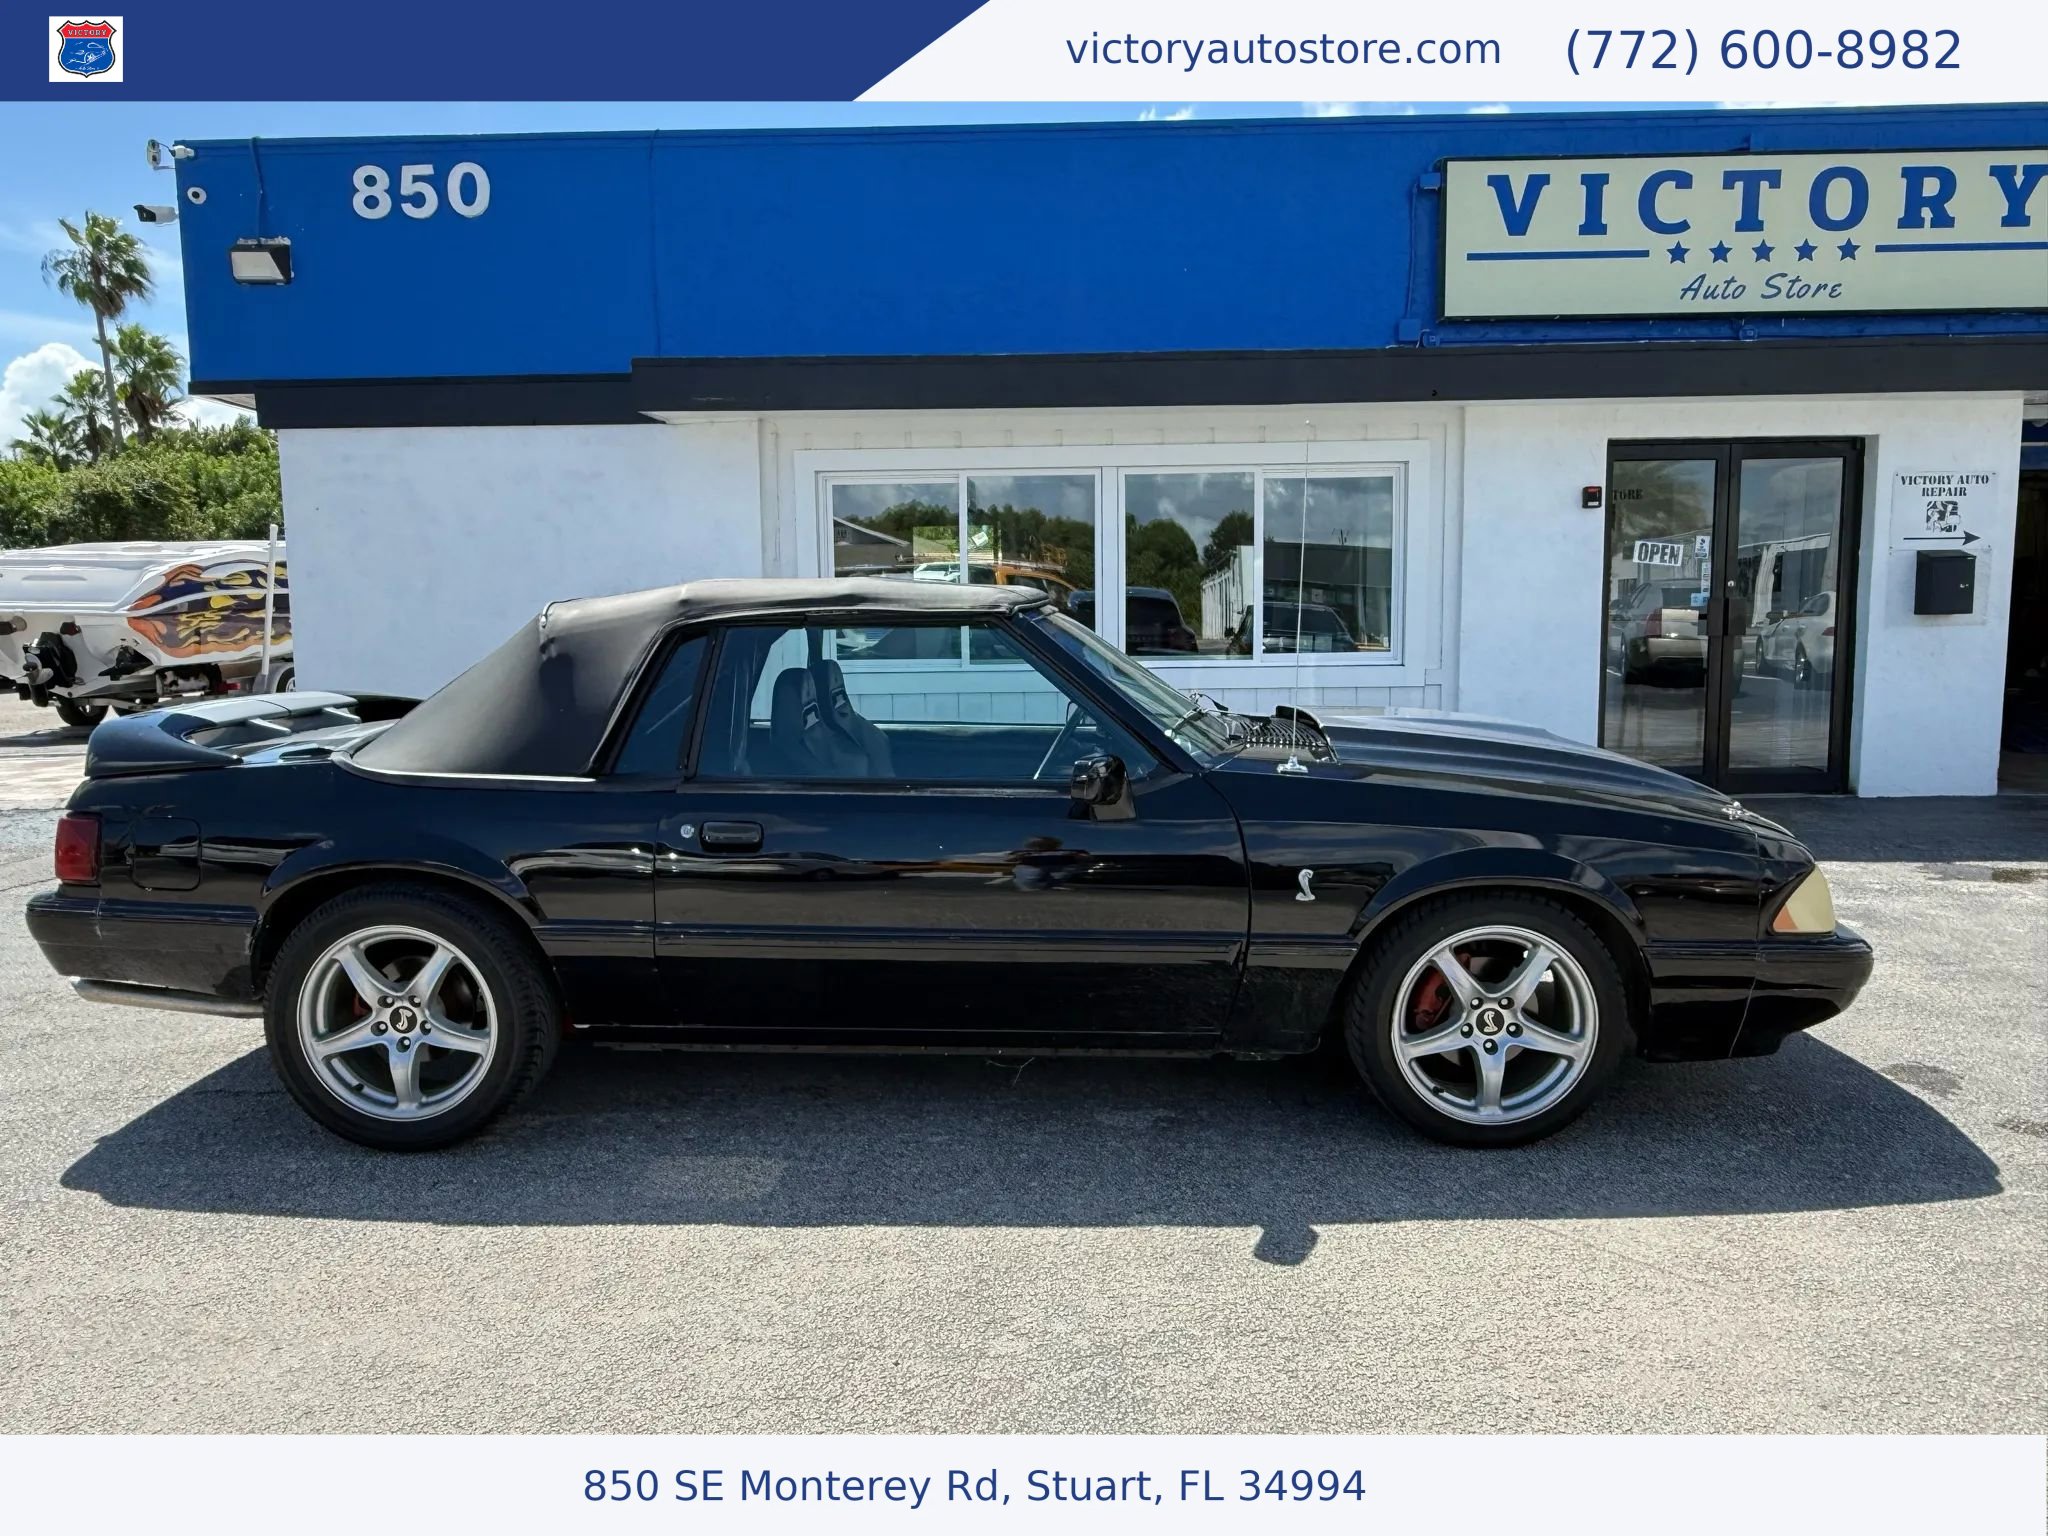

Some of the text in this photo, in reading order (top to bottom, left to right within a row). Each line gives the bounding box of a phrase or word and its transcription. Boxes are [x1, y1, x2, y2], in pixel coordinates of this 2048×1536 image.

[352, 161, 491, 220] 850
[1487, 164, 2048, 237] VICTORY
[1680, 271, 1843, 301] Auto Store
[1901, 474, 1989, 485] VICTORY AUTO
[1613, 489, 1644, 500] TORE
[1922, 487, 1967, 497] REPAIR
[1637, 542, 1681, 565] OPEN
